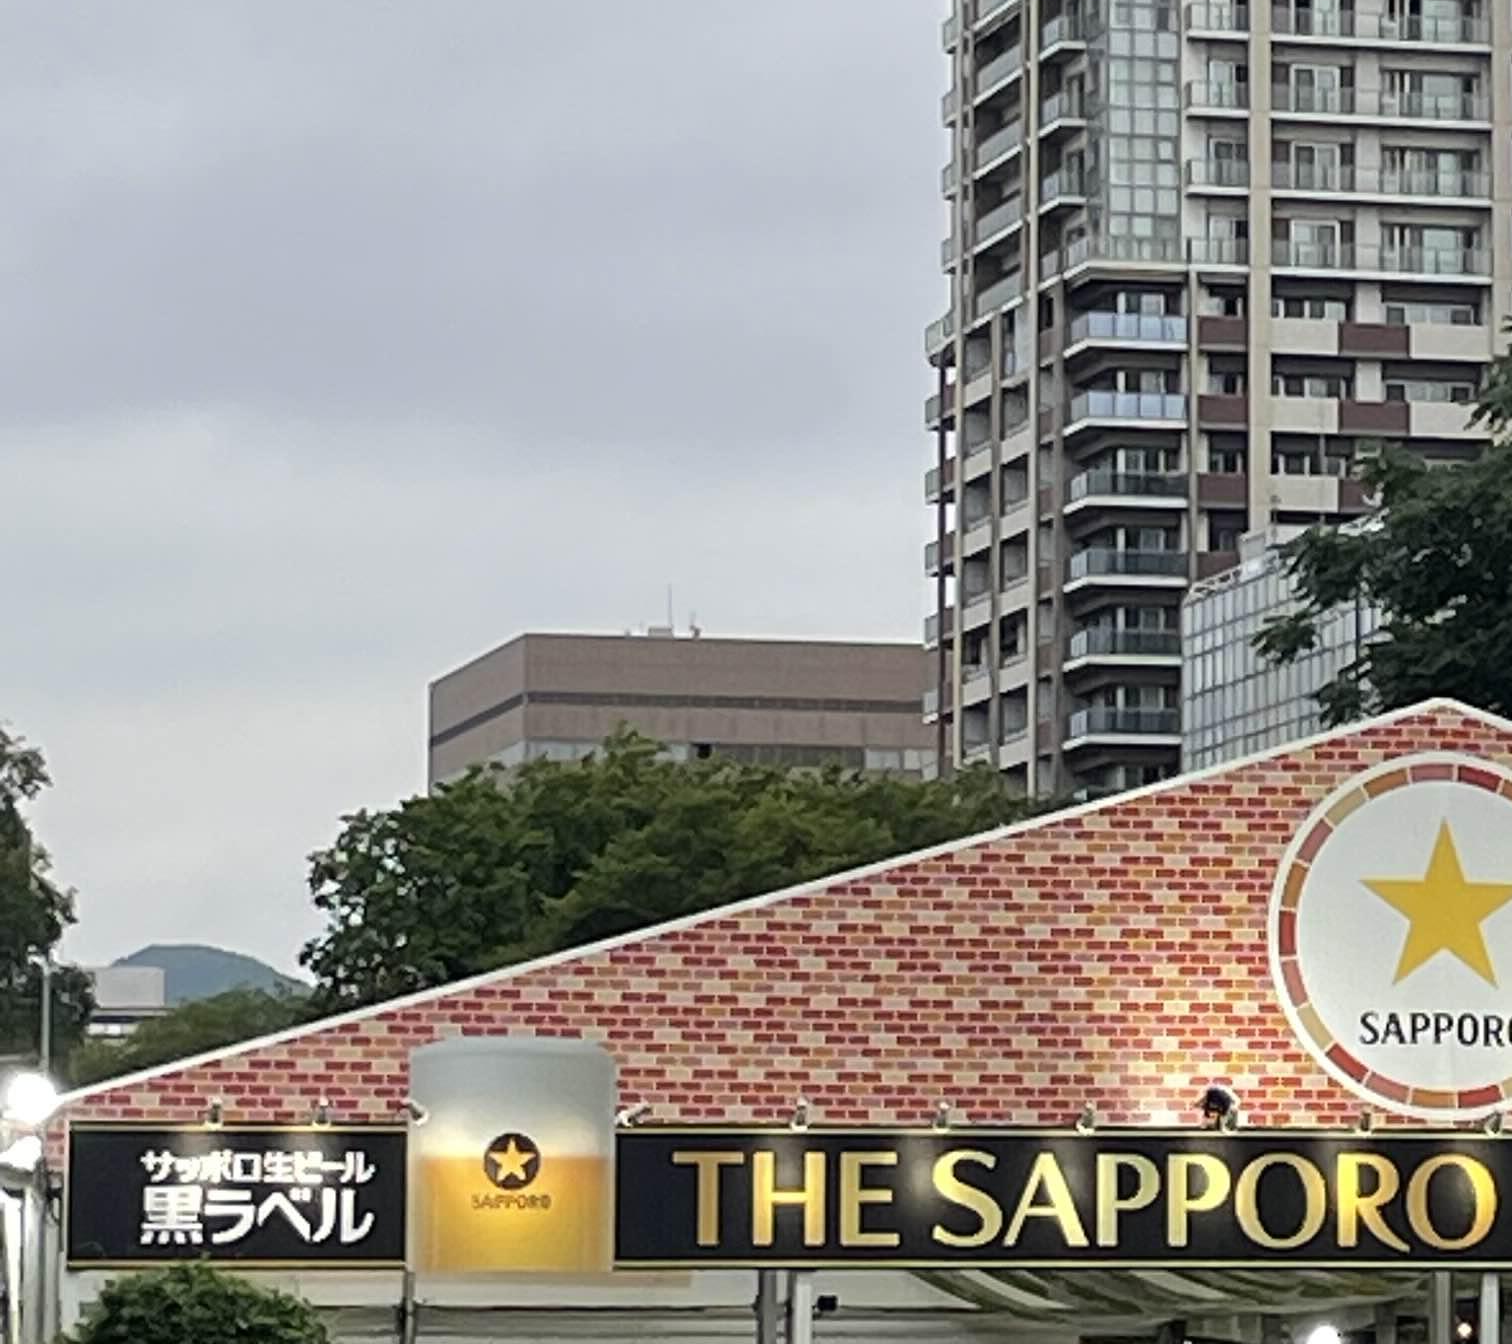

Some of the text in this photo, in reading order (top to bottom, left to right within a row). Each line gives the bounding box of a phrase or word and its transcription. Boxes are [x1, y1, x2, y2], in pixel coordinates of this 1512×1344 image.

[140, 1148, 376, 1184] サッポロ生ビール
[139, 1183, 376, 1245] 黒ラベル
[672, 1150, 901, 1248] THE
[931, 1149, 1498, 1253] SAPPORO
